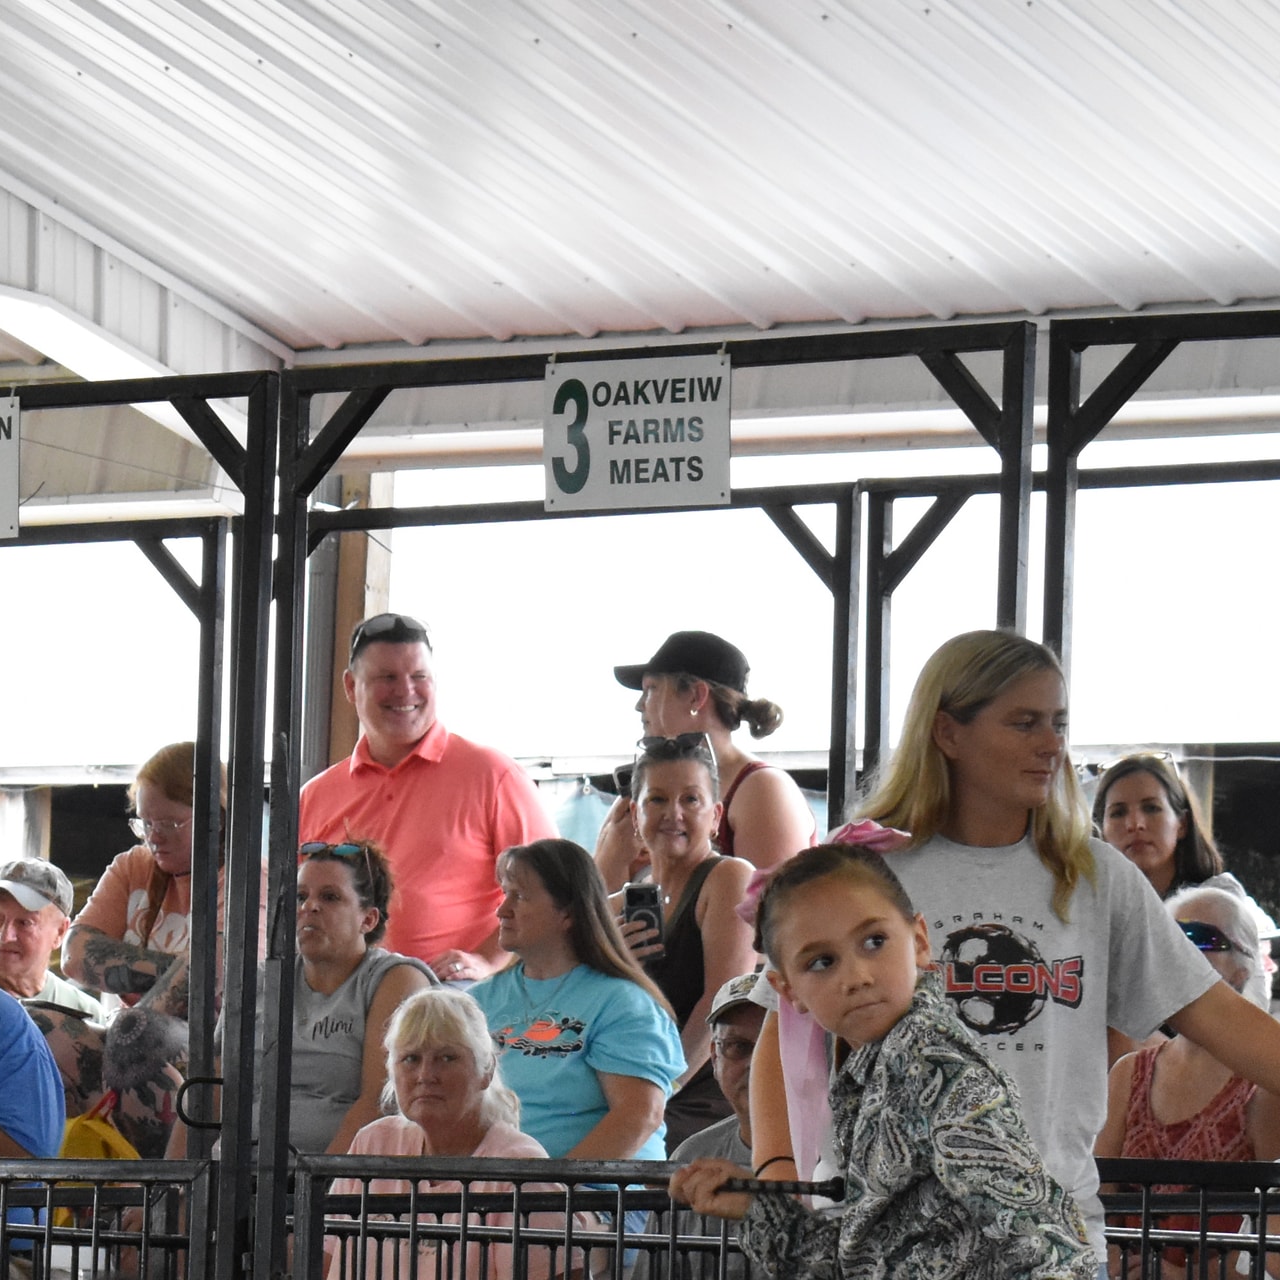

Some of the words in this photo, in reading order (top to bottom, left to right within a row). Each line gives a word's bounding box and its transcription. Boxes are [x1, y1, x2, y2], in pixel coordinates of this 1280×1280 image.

[592, 376, 722, 407] OAKVEIW
[552, 378, 591, 495] 3
[608, 416, 704, 446] FARMS
[609, 456, 704, 485] MEATS
[934, 912, 1044, 931] GRAHAM
[922, 955, 1084, 1010] LCONS
[312, 1015, 354, 1040] Mimi
